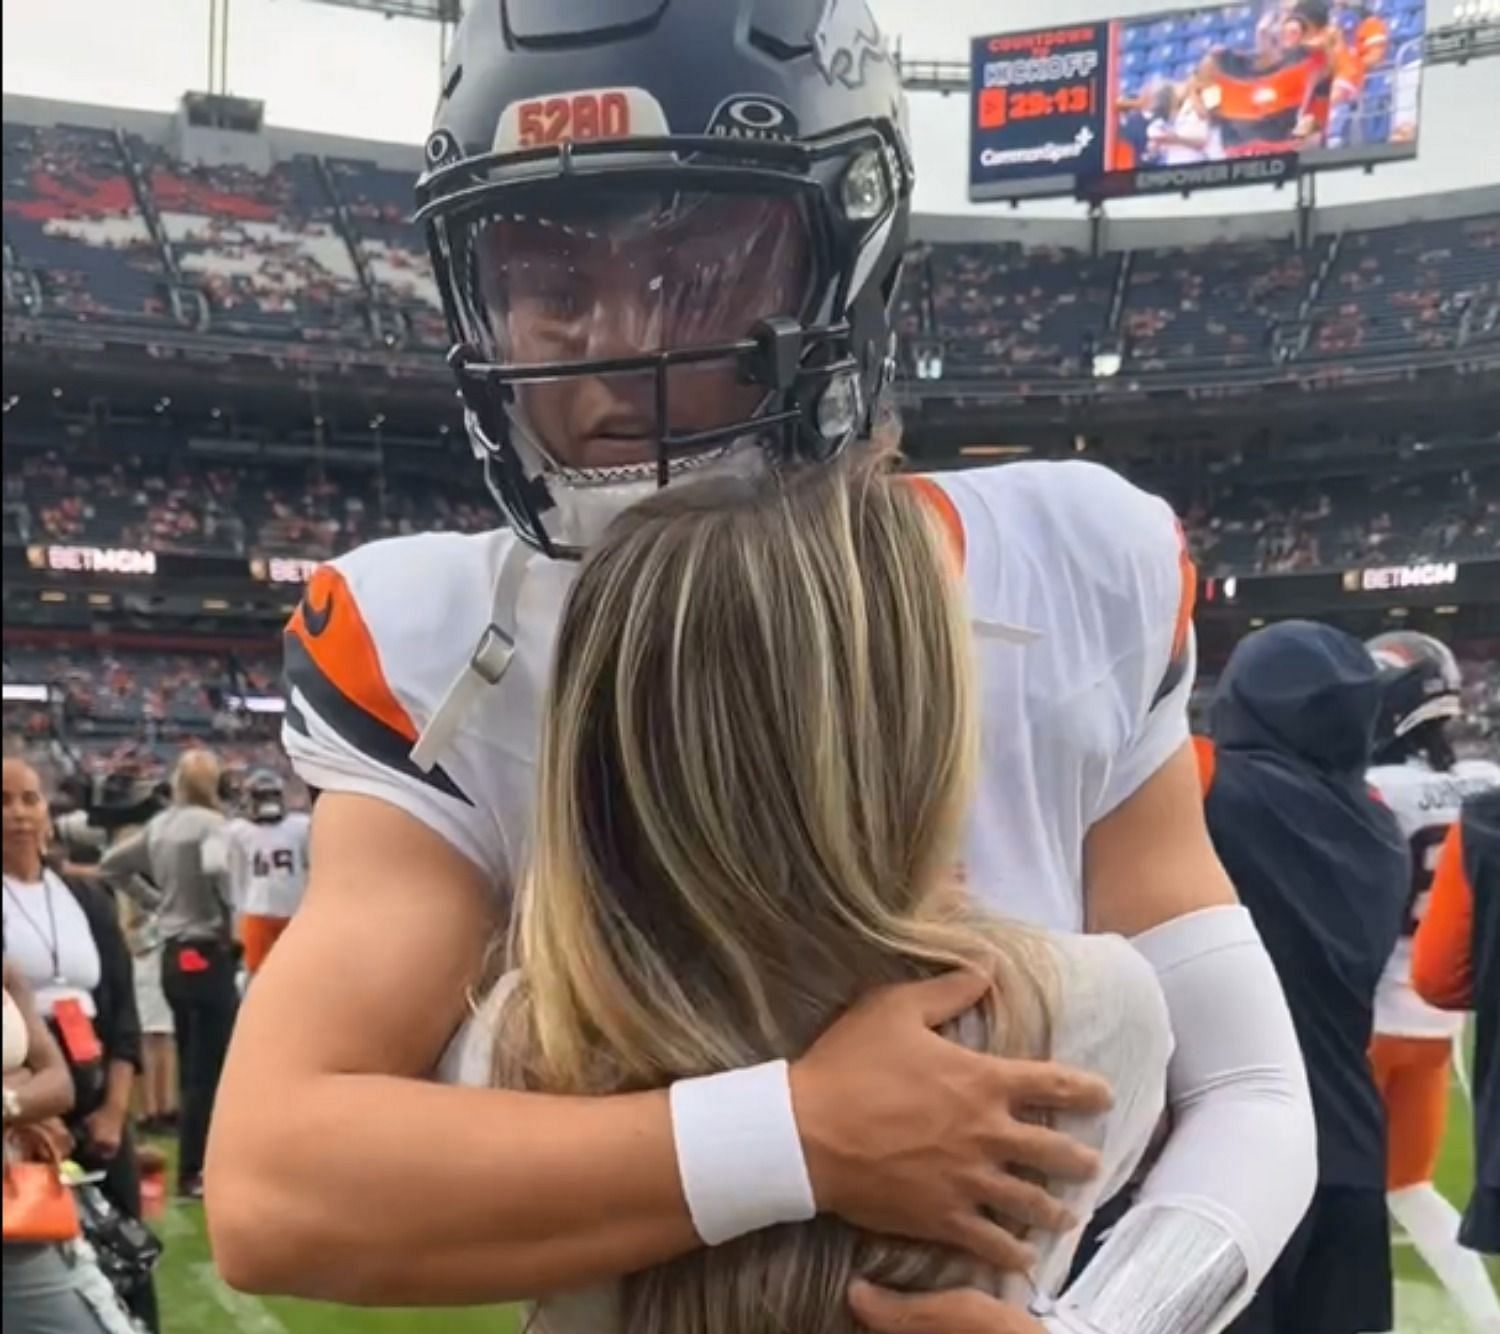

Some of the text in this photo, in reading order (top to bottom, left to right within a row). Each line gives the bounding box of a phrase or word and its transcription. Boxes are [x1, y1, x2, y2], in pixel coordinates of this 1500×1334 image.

[988, 27, 1094, 52] COUNTDOWN
[983, 51, 1098, 85] KICKOFF
[519, 93, 629, 146] 5280
[714, 124, 794, 143] OAKLEY
[1135, 159, 1286, 190] EMPOWER FIELD
[48, 545, 157, 574] BETMGM
[1363, 563, 1456, 589] BETMGM
[253, 849, 295, 877] 69
